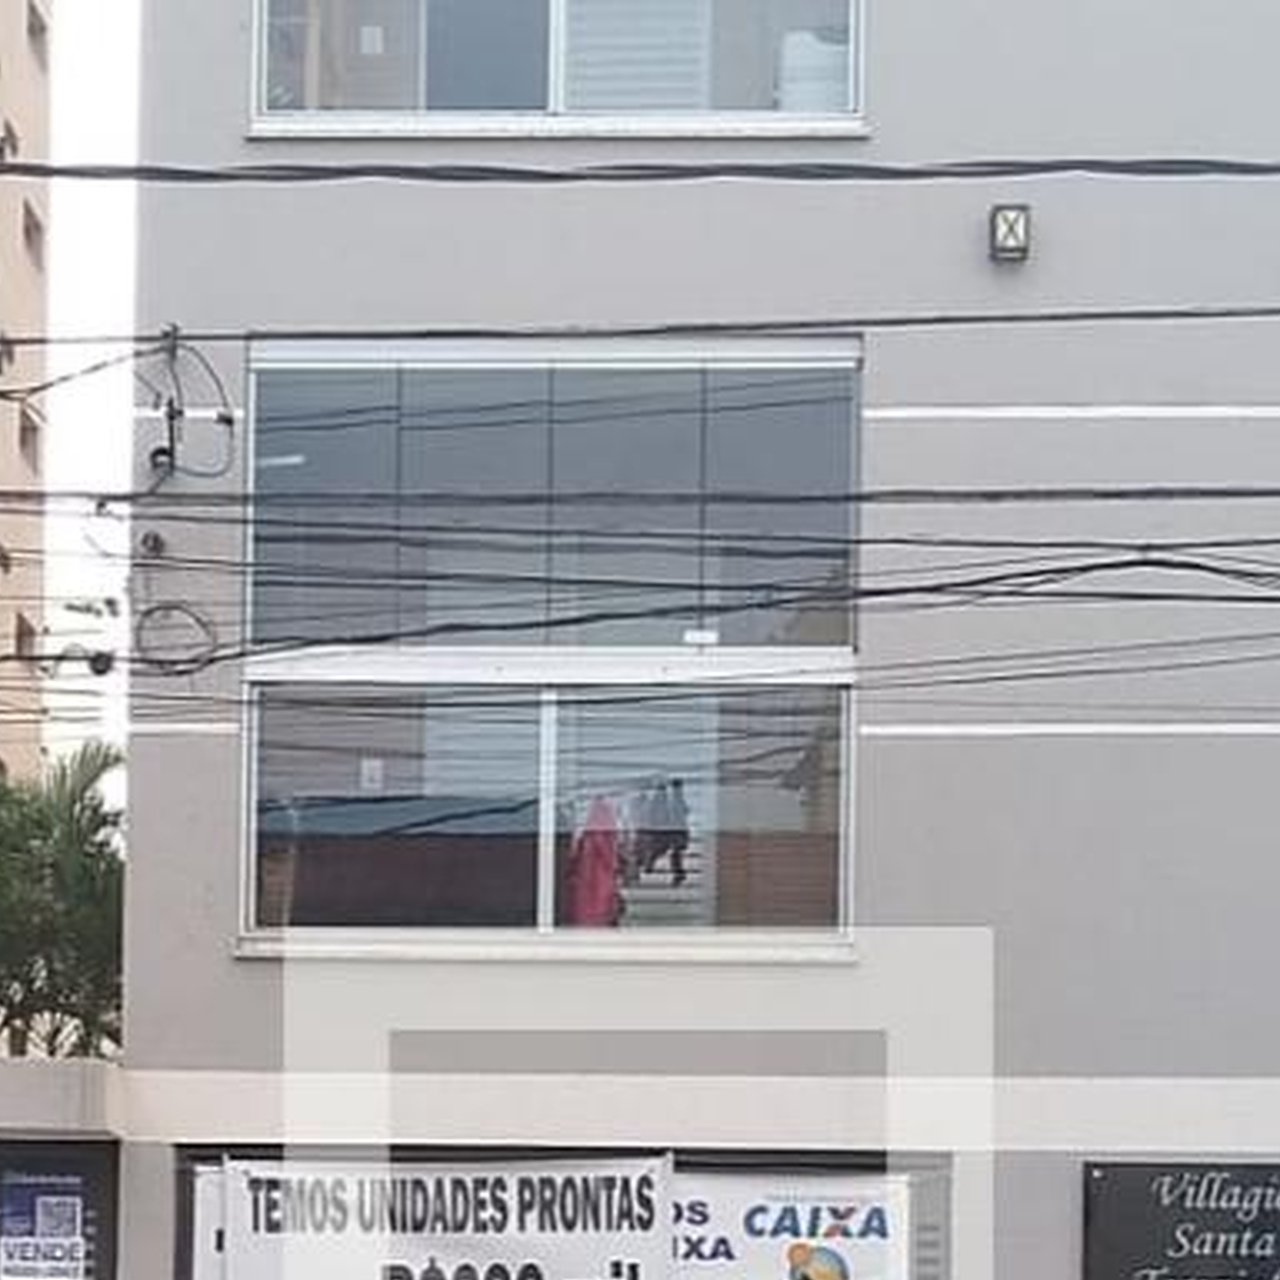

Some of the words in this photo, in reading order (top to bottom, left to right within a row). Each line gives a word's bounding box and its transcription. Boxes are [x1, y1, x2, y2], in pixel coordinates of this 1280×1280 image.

[248, 1177, 348, 1233] TEMOS
[357, 1176, 508, 1233] UNIDADES
[517, 1175, 655, 1232] PRONTAS
[743, 1204, 890, 1239] CAIXA
[1168, 1222, 1276, 1258] Santa
